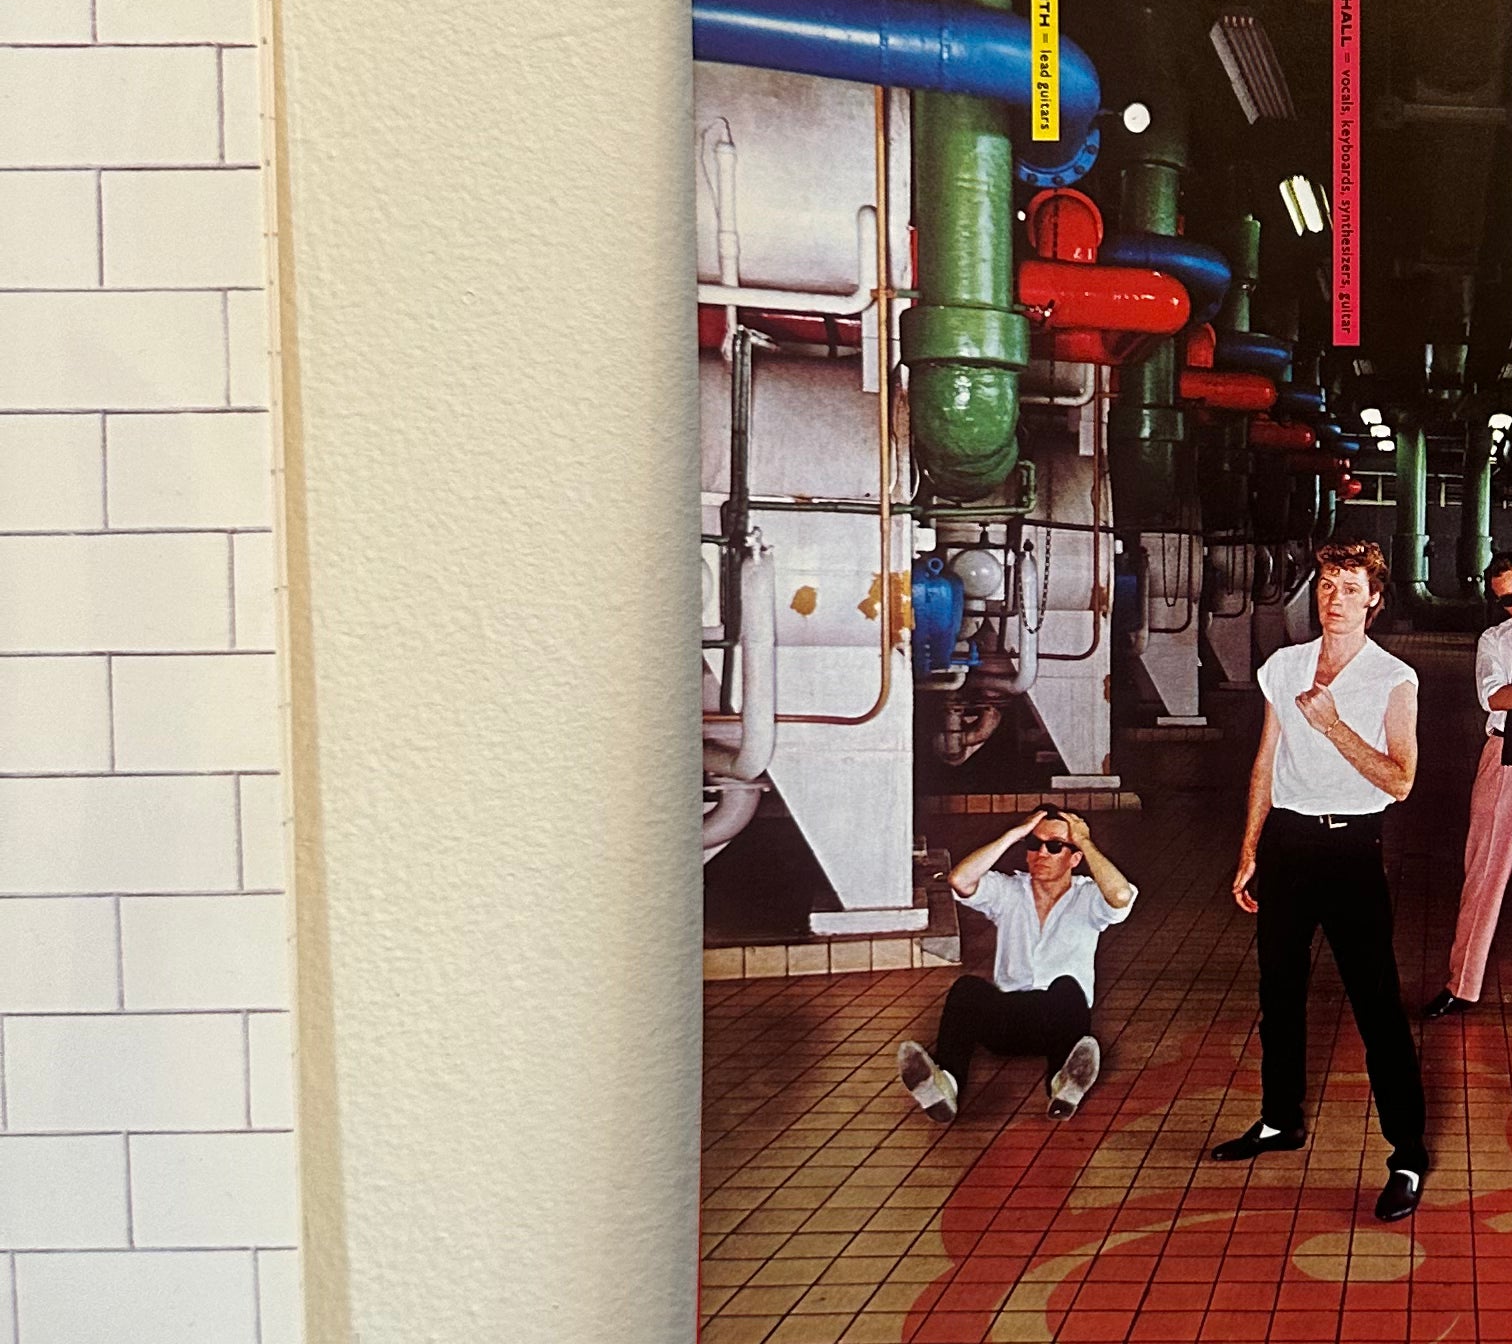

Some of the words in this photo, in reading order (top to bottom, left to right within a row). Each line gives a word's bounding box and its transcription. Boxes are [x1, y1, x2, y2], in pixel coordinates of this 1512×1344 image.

[1039, 50, 1052, 78] lead
[1036, 82, 1050, 131] guitars
[1340, 69, 1355, 116] vocals,
[1338, 120, 1354, 195] keyboards,
[1337, 200, 1355, 289] synthesizers,
[1337, 292, 1352, 335] guitar
